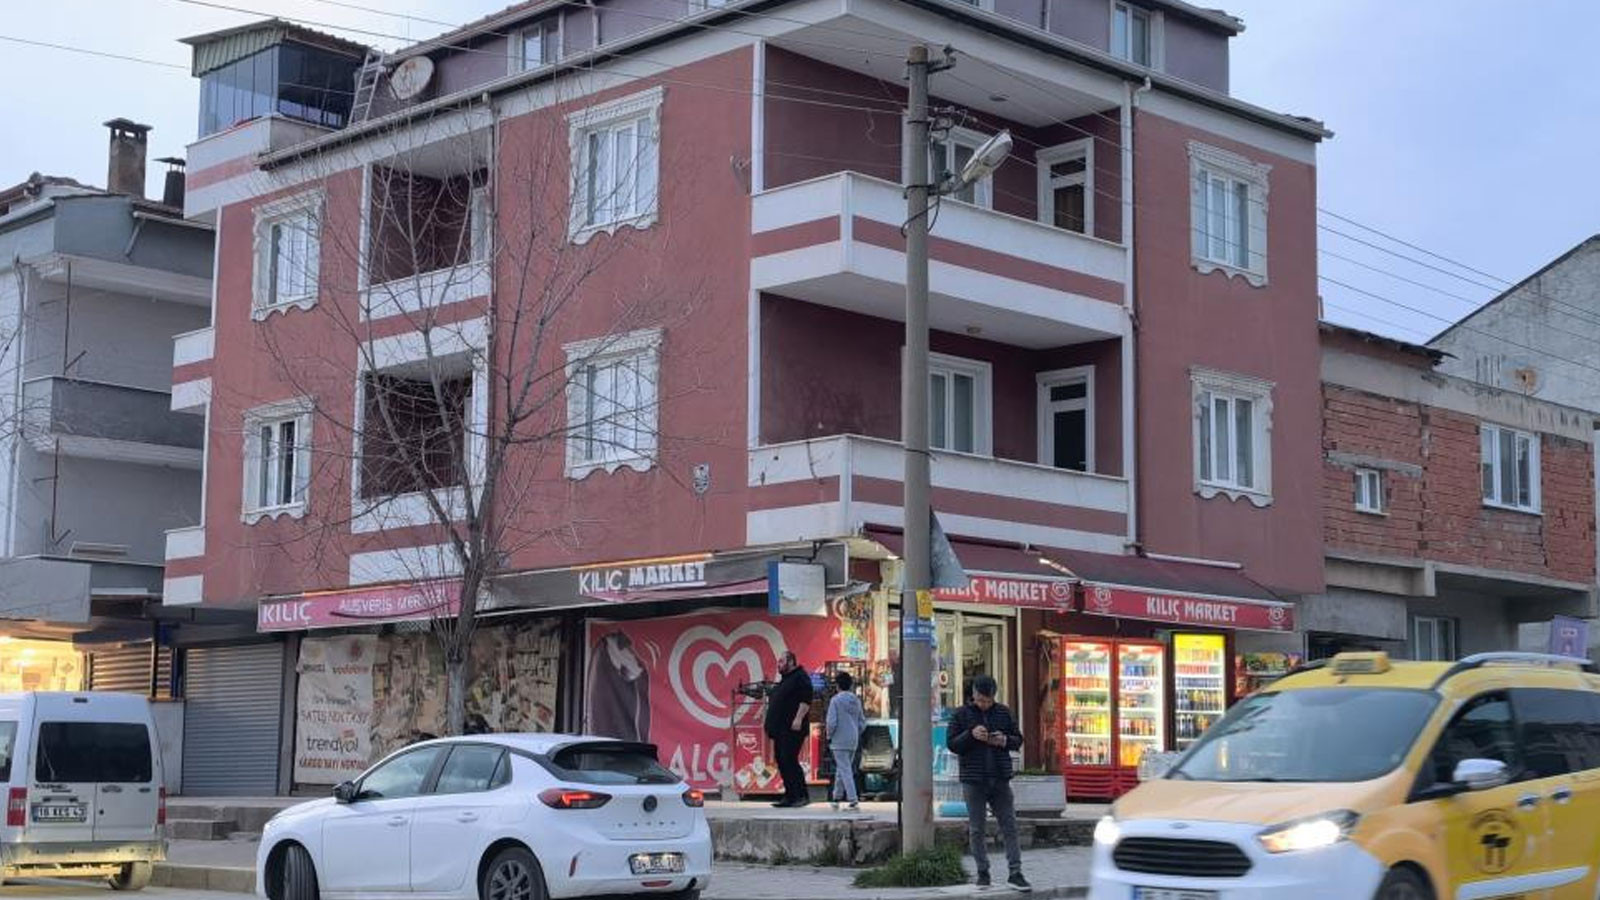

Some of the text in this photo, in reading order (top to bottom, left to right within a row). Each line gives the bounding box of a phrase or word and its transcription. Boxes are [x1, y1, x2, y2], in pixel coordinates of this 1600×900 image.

[628, 562, 705, 586] MARKET
[985, 580, 1048, 602] MARKET
[261, 602, 312, 625] KILIÇ
[1146, 597, 1238, 622] KILIÇ MARKET
[306, 736, 359, 753] trendyol
